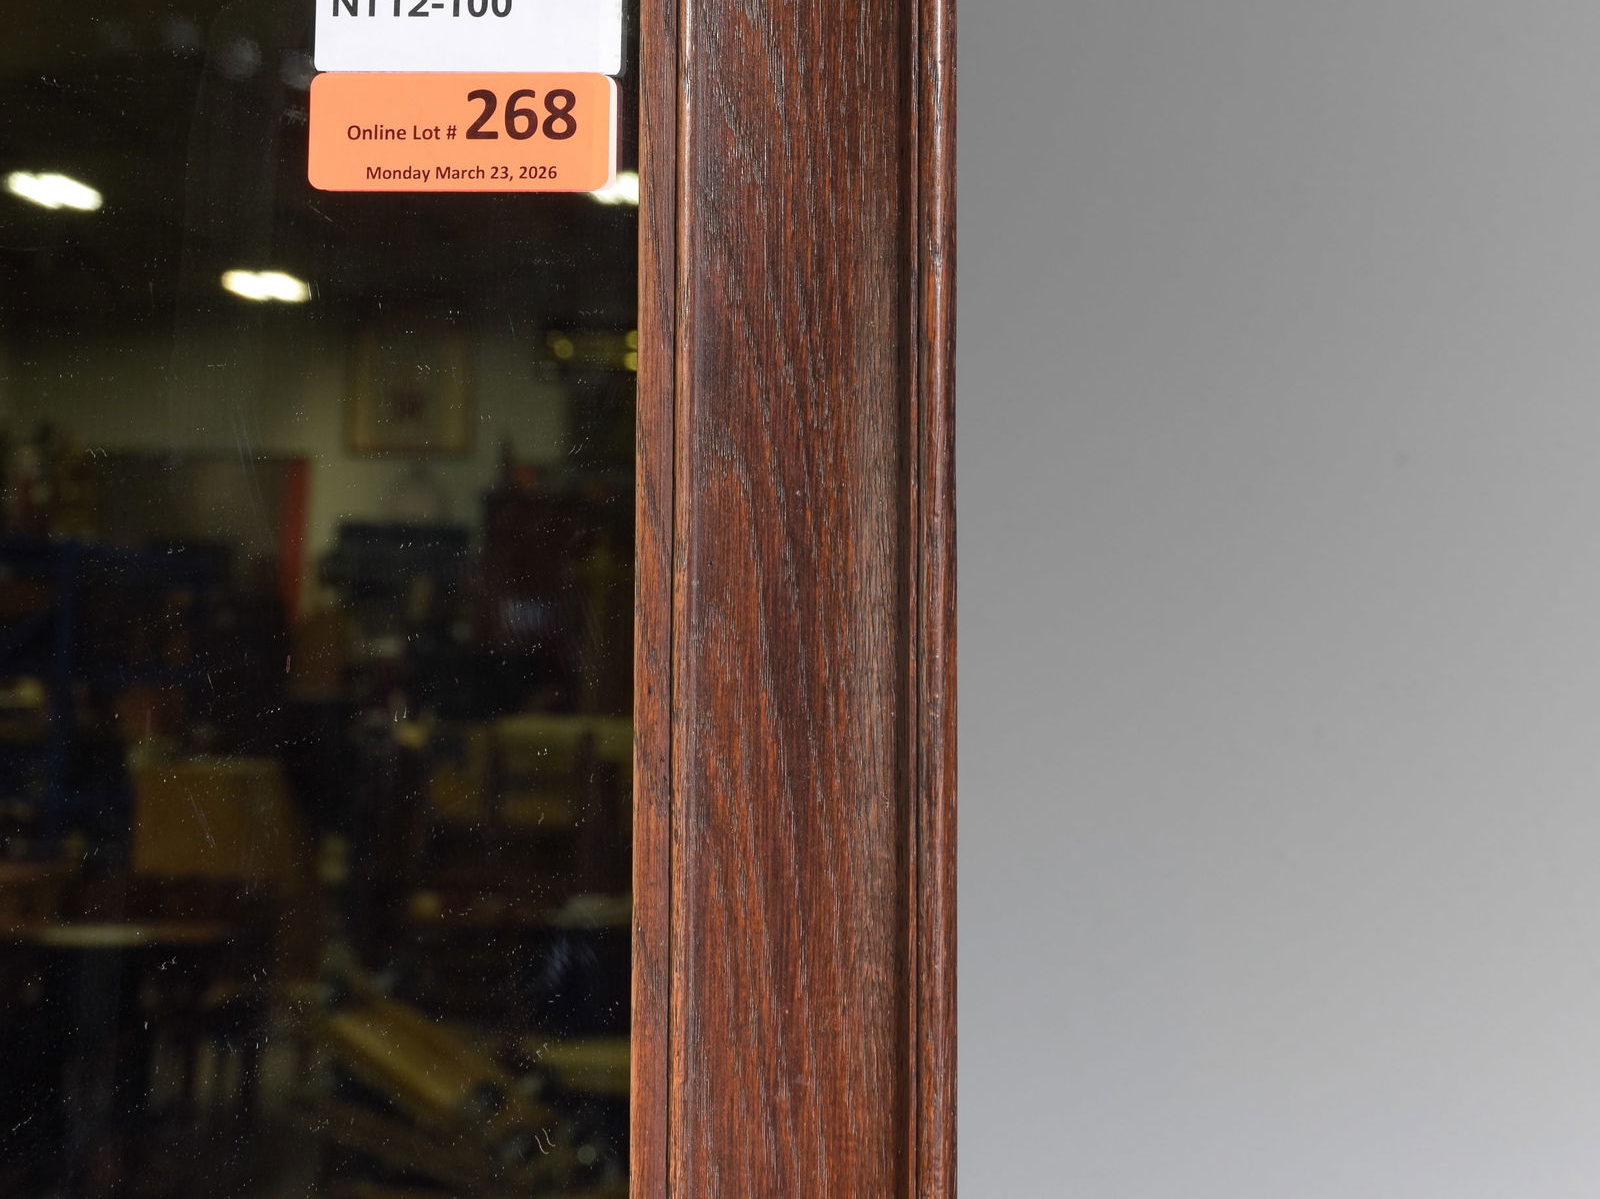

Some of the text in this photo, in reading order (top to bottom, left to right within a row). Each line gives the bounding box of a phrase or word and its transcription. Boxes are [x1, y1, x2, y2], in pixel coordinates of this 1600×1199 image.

[347, 89, 578, 141] Online Lot # 268
[366, 166, 558, 182] Monday March 23, 2026
